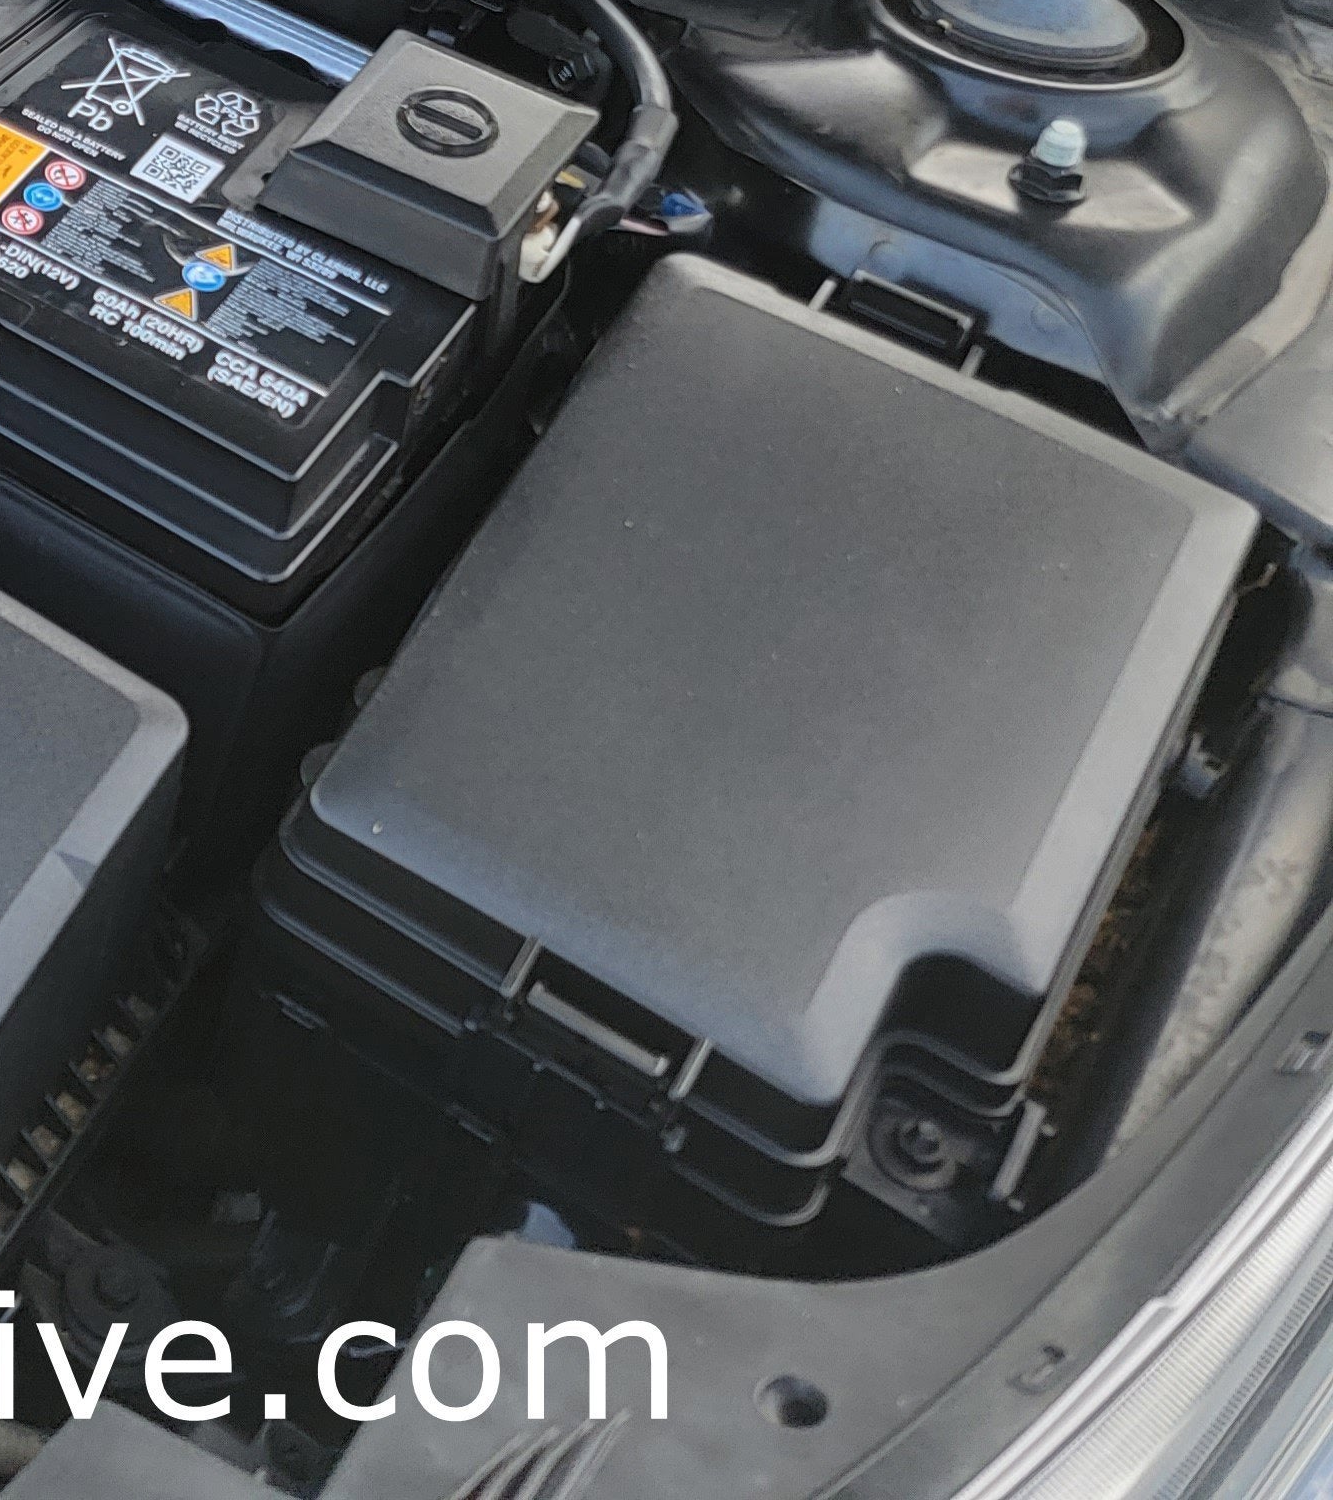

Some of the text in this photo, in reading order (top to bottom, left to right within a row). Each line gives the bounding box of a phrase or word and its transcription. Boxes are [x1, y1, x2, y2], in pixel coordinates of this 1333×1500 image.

[68, 100, 113, 131] Pb
[89, 304, 121, 324] RC
[215, 352, 308, 406] CCA 640A
